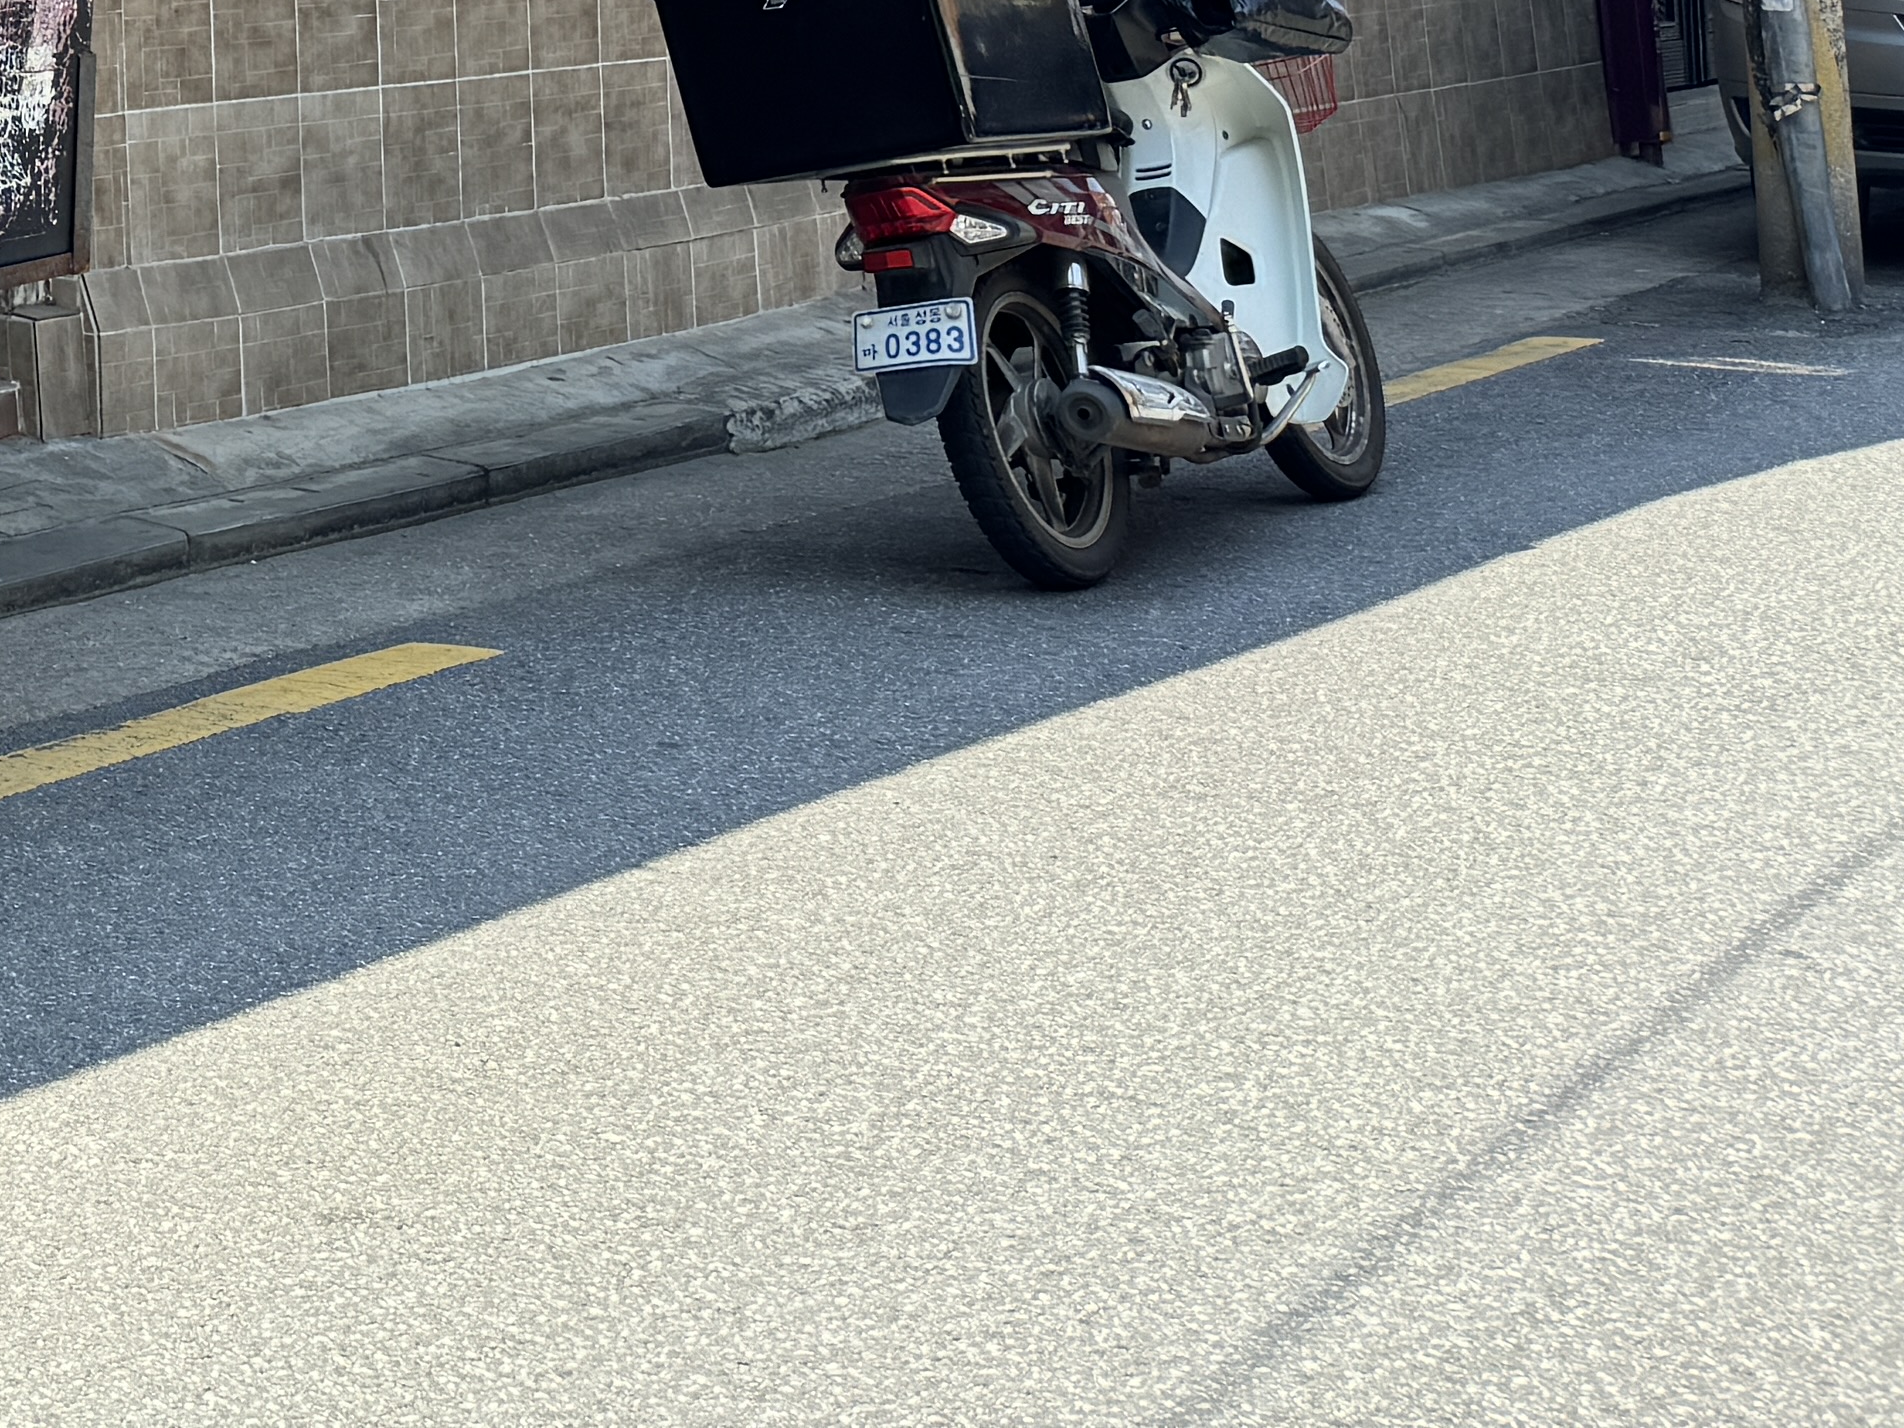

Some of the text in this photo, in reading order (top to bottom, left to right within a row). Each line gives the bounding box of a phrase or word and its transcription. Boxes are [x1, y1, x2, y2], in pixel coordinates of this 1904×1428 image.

[887, 312, 911, 327] 서울
[862, 326, 965, 361] 마 0383
